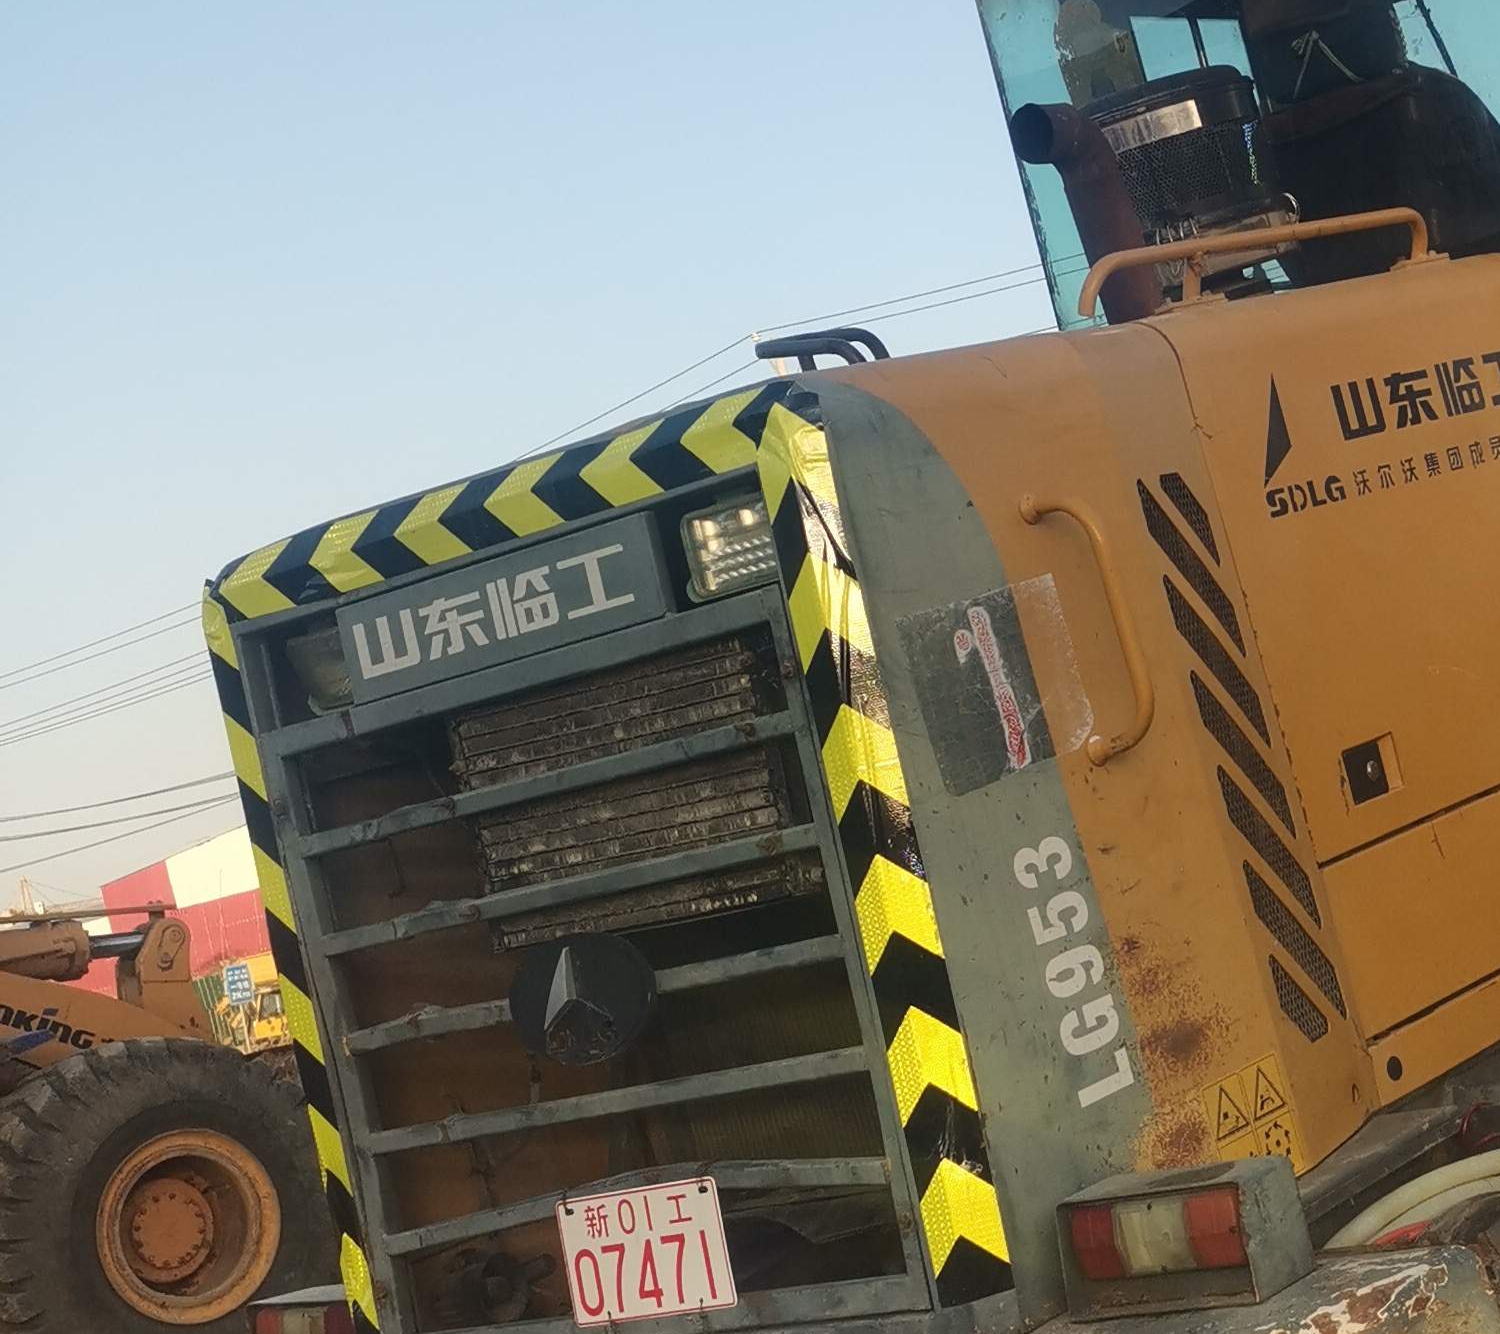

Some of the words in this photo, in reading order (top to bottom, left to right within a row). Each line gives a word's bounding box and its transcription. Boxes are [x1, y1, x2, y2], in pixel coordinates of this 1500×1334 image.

[1265, 474, 1346, 518] SDLG
[352, 543, 635, 680] 山东临工
[1013, 835, 1136, 1109] LG953
[574, 1229, 718, 1317] 07471
